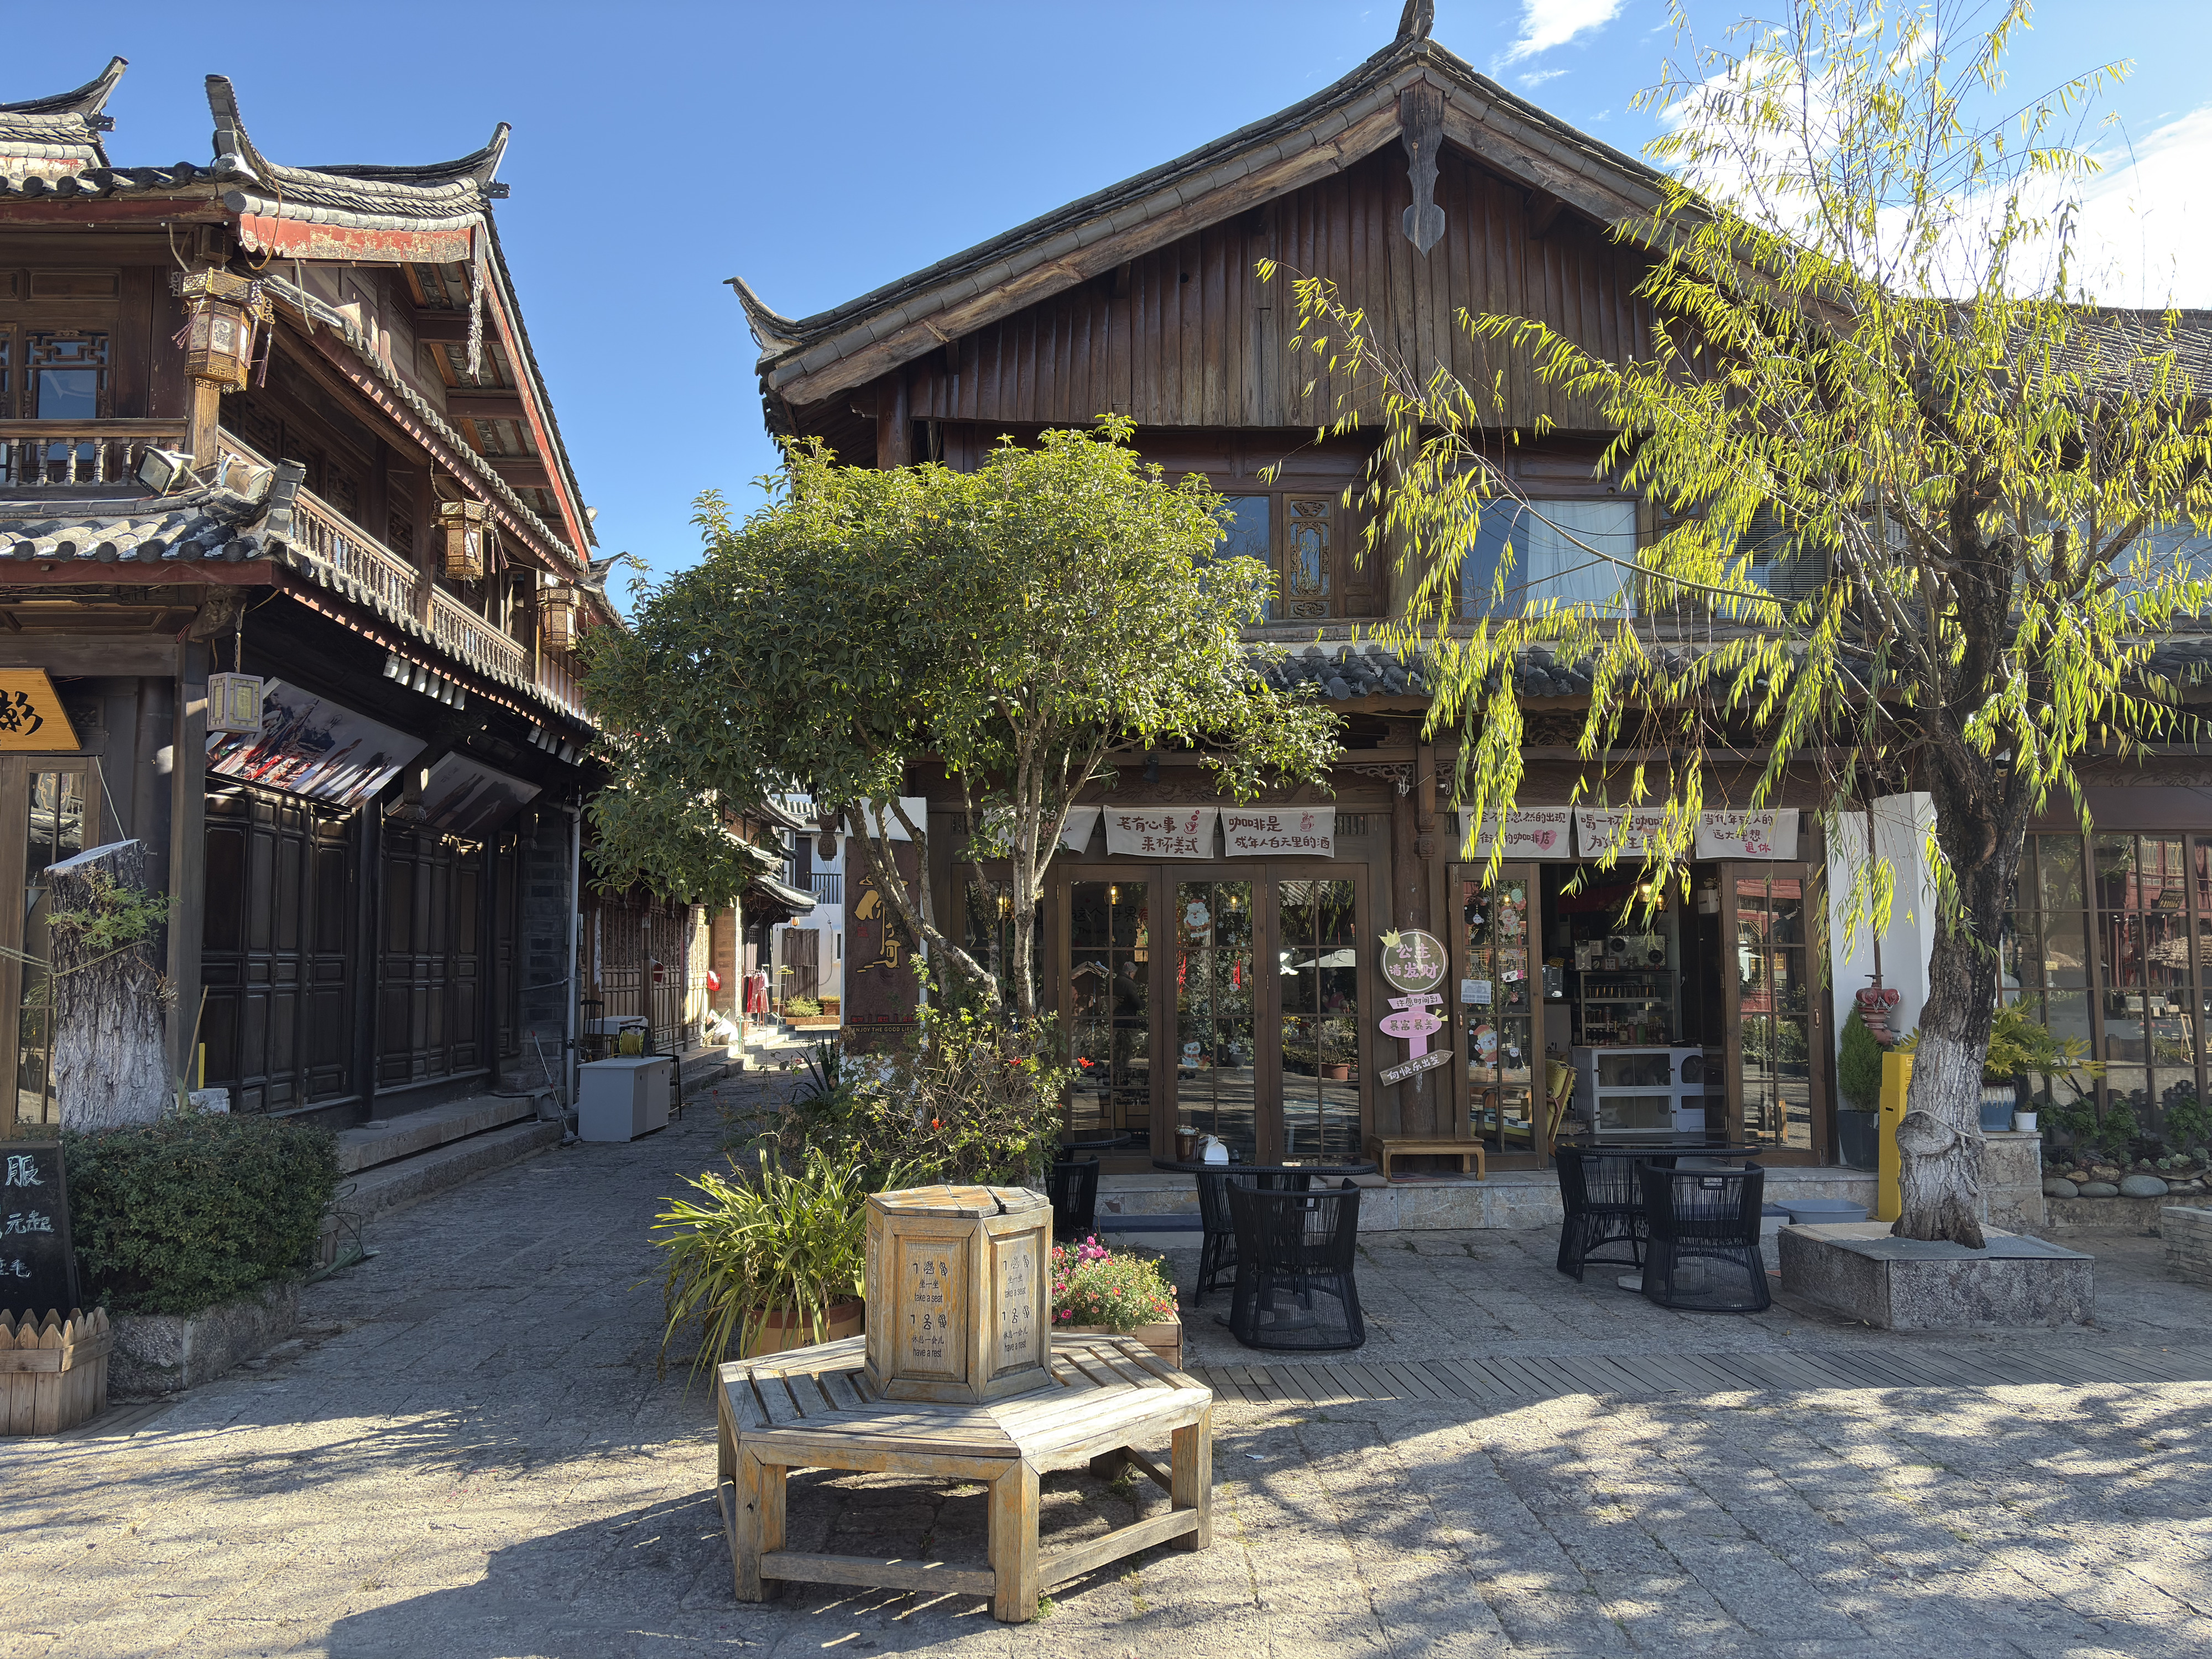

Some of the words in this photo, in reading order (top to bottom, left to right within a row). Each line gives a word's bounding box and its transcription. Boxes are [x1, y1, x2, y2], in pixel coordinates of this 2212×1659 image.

[1117, 816, 1177, 833] 若有心事
[1229, 816, 1282, 832] 咖啡是
[1234, 836, 1330, 849] 成年人白天里的酒
[1469, 831, 1550, 845] 街的咖啡店
[1141, 836, 1199, 854] 来杯美式
[1745, 842, 1771, 854] 退休
[1396, 942, 1431, 959] 公主
[1389, 962, 1438, 979] 请发财
[1396, 995, 1438, 1007] 许愿时间到
[1387, 1054, 1439, 1079] 向快乐出发
[5, 1155, 45, 1187] 服
[919, 1279, 939, 1289] 坐一坐
[1008, 1273, 1022, 1284] 坐一坐
[915, 1292, 926, 1302] take
[931, 1293, 943, 1302] seat
[1004, 1288, 1013, 1298] take
[1018, 1286, 1026, 1296] seat
[912, 1334, 944, 1344] 休息一会儿
[1004, 1327, 1028, 1339] 休息一会儿
[913, 1347, 926, 1357] have
[932, 1349, 942, 1358] rest
[1004, 1343, 1014, 1353] have
